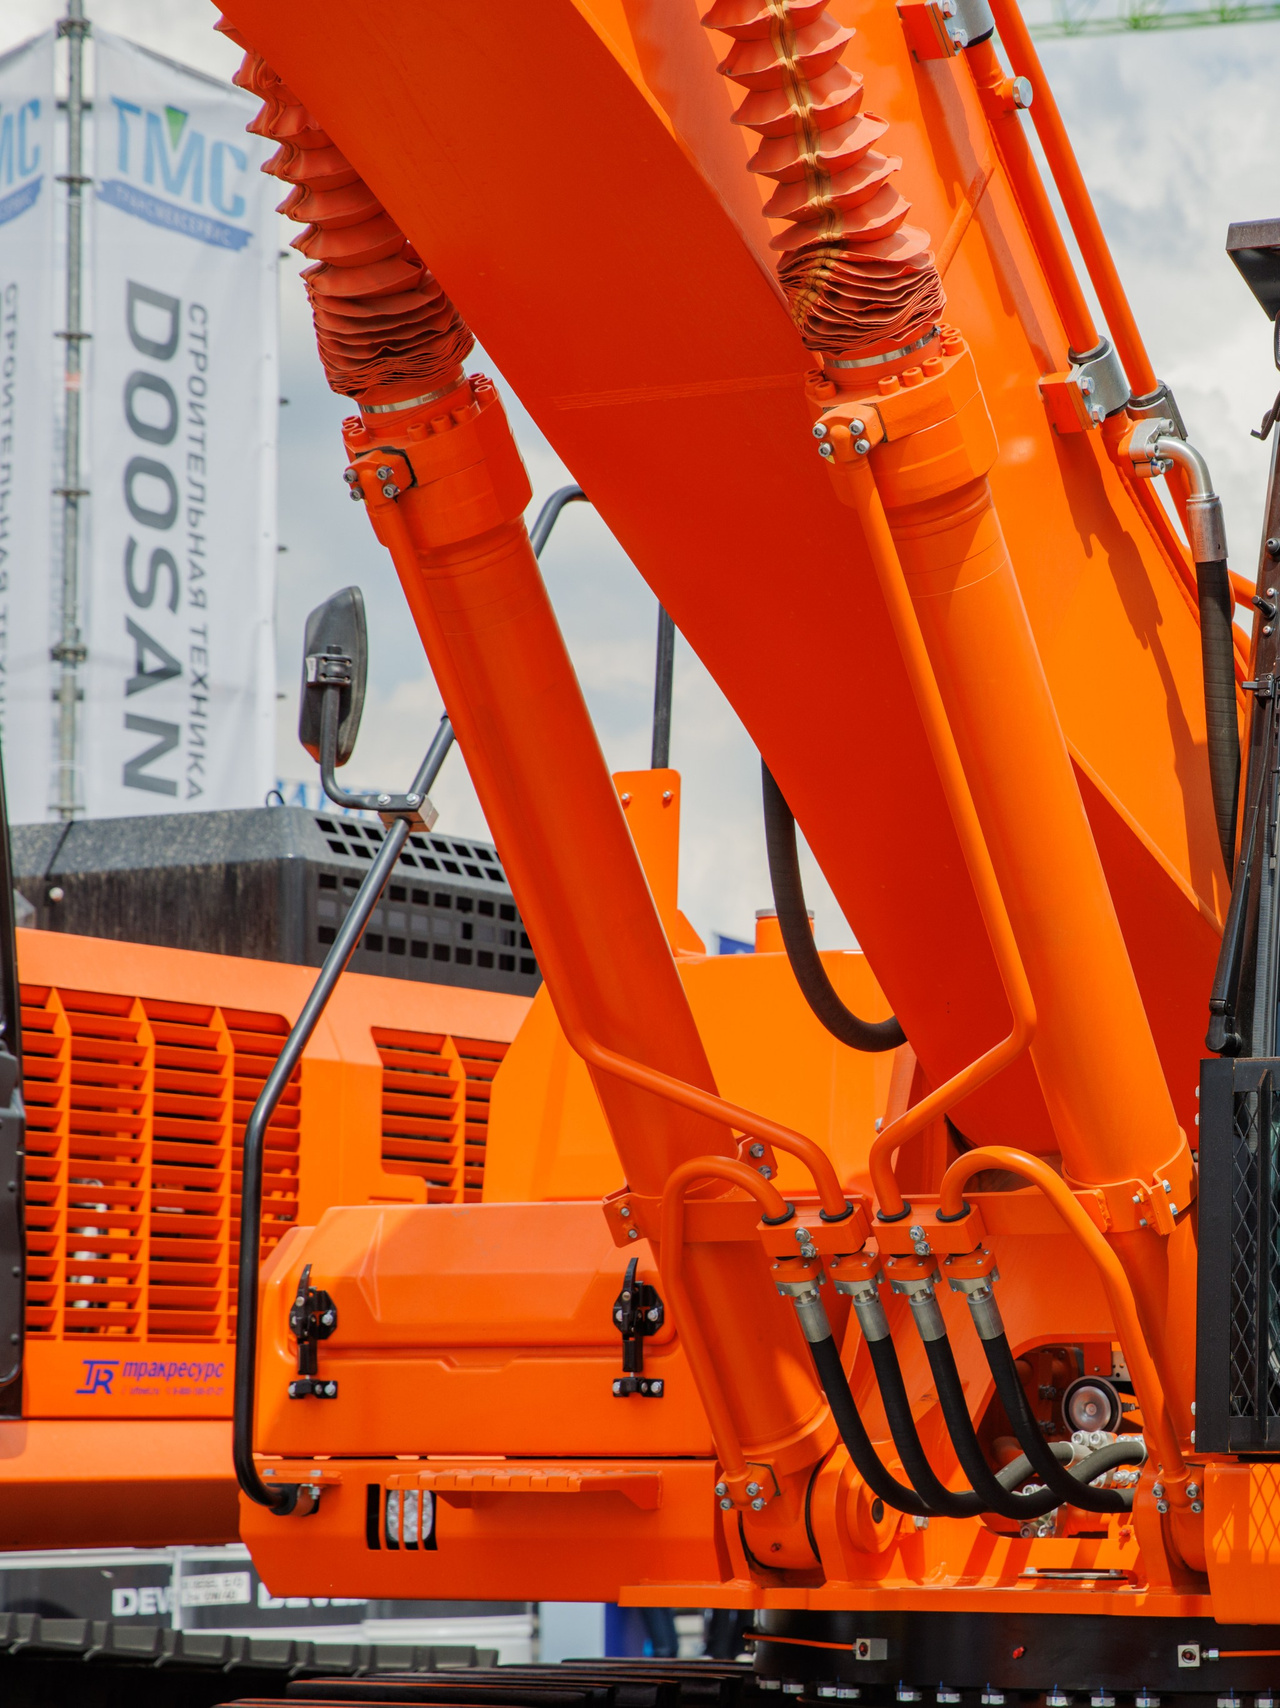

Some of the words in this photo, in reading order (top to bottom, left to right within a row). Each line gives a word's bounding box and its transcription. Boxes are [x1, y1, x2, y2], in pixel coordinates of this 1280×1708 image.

[123, 279, 182, 797] DOOSAN
[186, 302, 209, 609] СТРОИТЕЛЬНАЯ
[185, 622, 209, 801] ТЕХНИКА
[122, 1361, 225, 1382] тракресурс
